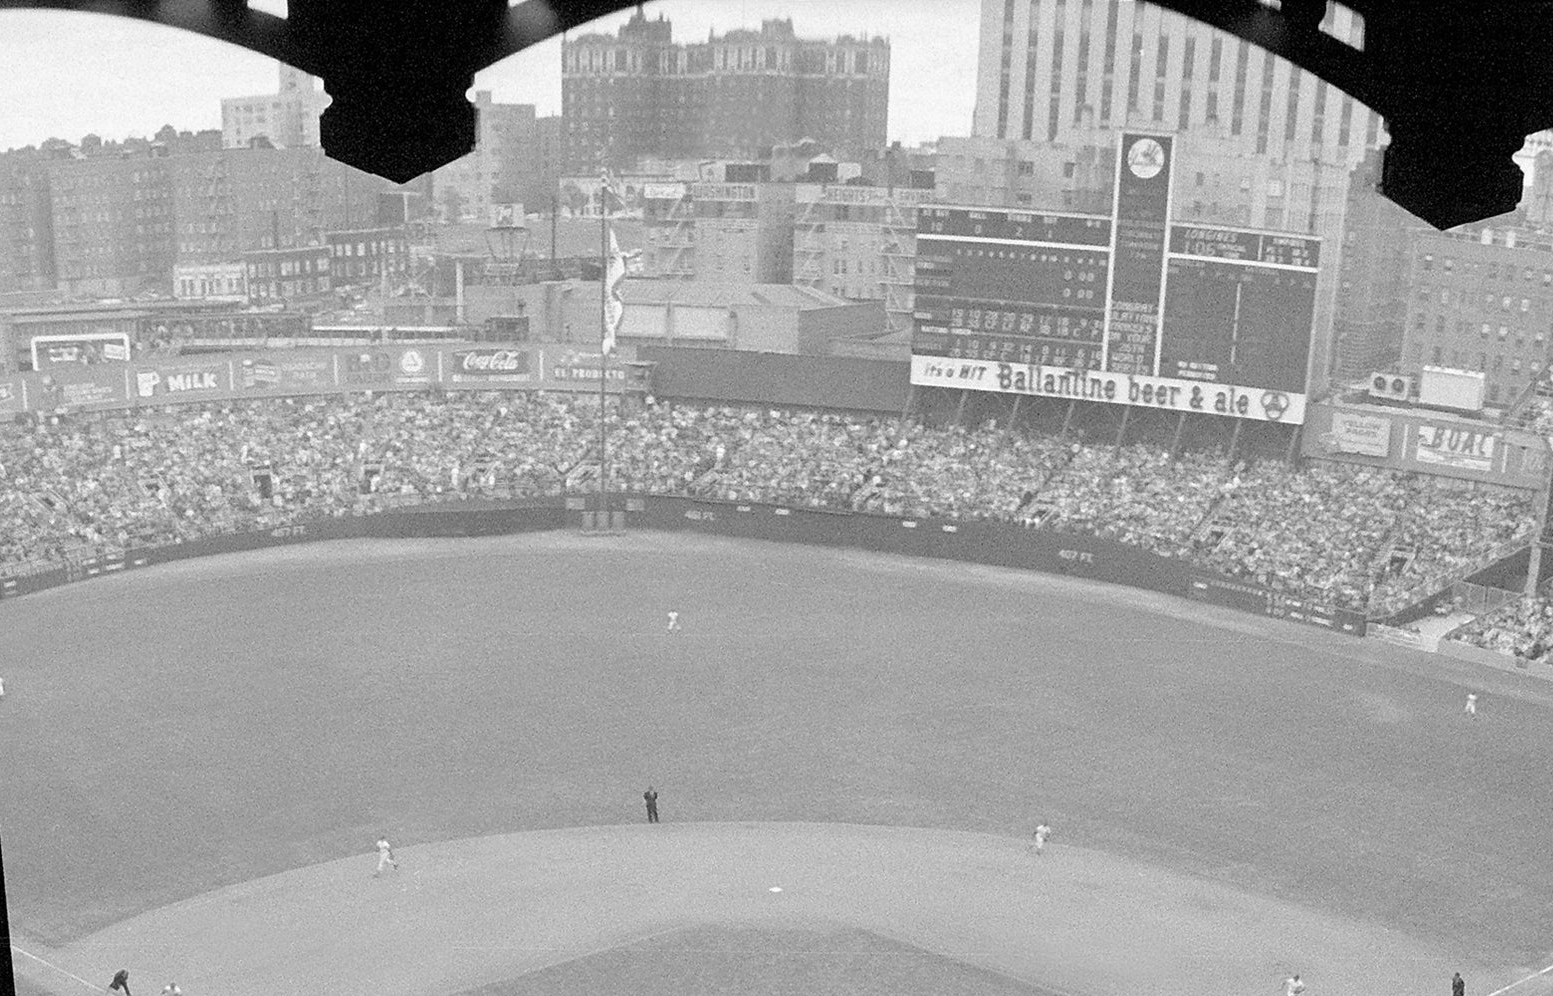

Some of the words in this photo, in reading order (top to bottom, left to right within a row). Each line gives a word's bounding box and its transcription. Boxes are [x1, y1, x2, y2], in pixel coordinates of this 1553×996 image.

[1184, 229, 1238, 243] LONGINES
[456, 351, 519, 371] Coca-Cola
[167, 372, 217, 392] MILK
[958, 365, 988, 383] HIT
[997, 364, 1116, 400] Ballantine
[1128, 375, 1182, 406] beer
[1189, 385, 1206, 410] &
[1214, 387, 1251, 414] ale
